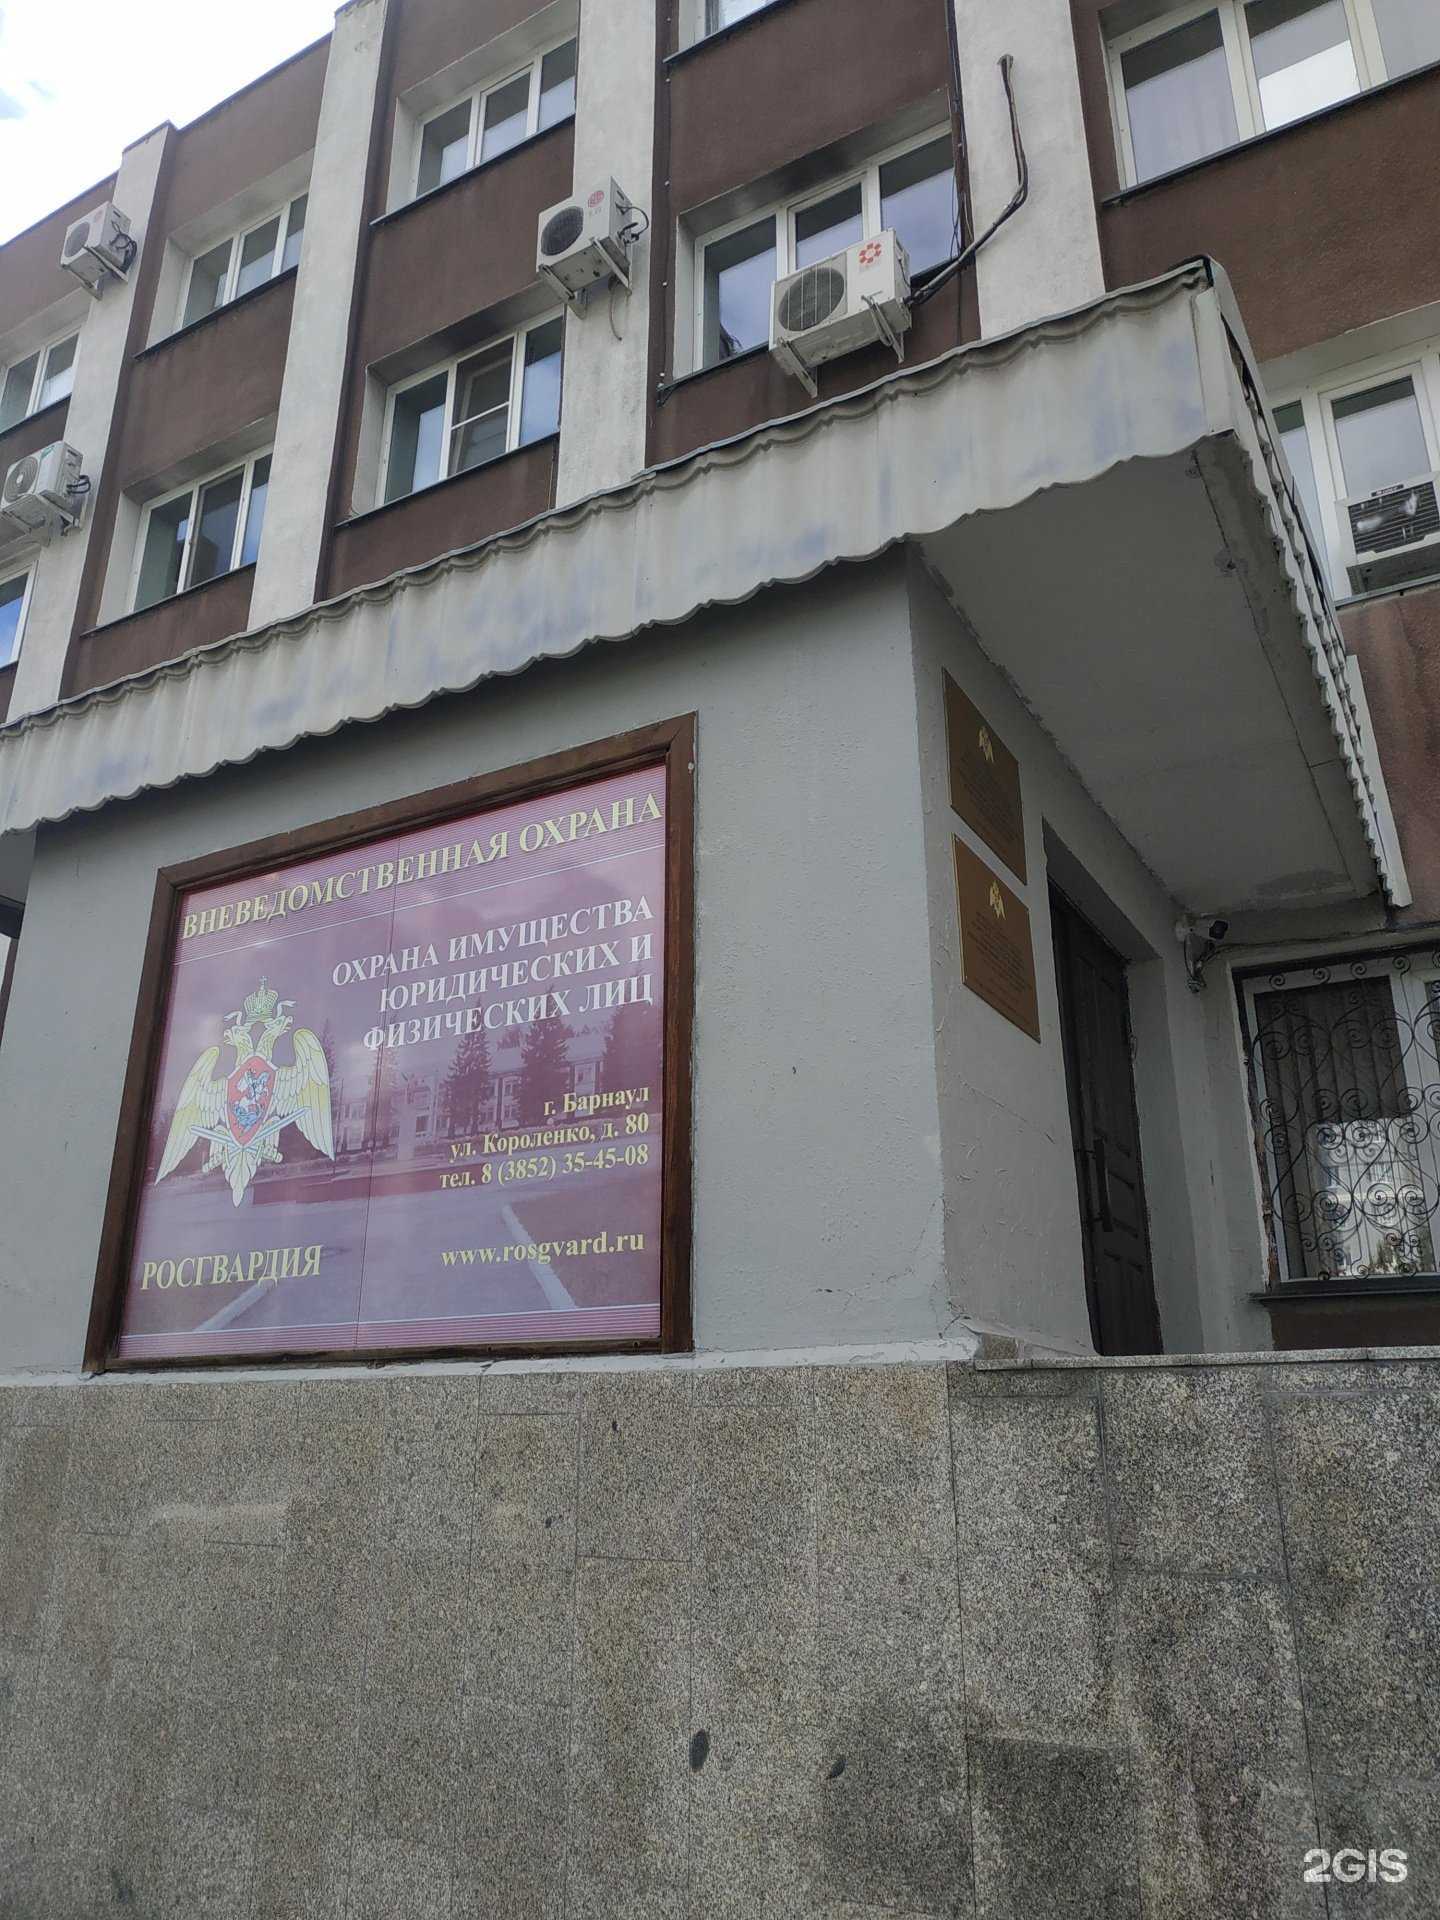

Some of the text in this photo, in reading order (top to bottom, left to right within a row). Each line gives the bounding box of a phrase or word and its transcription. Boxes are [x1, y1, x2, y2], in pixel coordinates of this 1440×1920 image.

[183, 793, 663, 939] ВНЕВЕДОМСТВЕННАЯ ОХРАНА
[332, 896, 655, 986] ОХРАНА ИМУЩЕСТВА
[379, 933, 654, 1013] ЮРИДИЧЕСКИХ И
[363, 973, 654, 1050] ФИЗИЧЕСКИХ ЛИЦ
[543, 1086, 650, 1116] г. Барнаул
[449, 1112, 649, 1163] ул. Короленко, д. 80
[440, 1143, 649, 1189] тел. 8 (3852) 35-45-08
[140, 1244, 324, 1290] РОСГВАРДИЯ
[441, 1231, 645, 1266] www.rosgvard.ru
